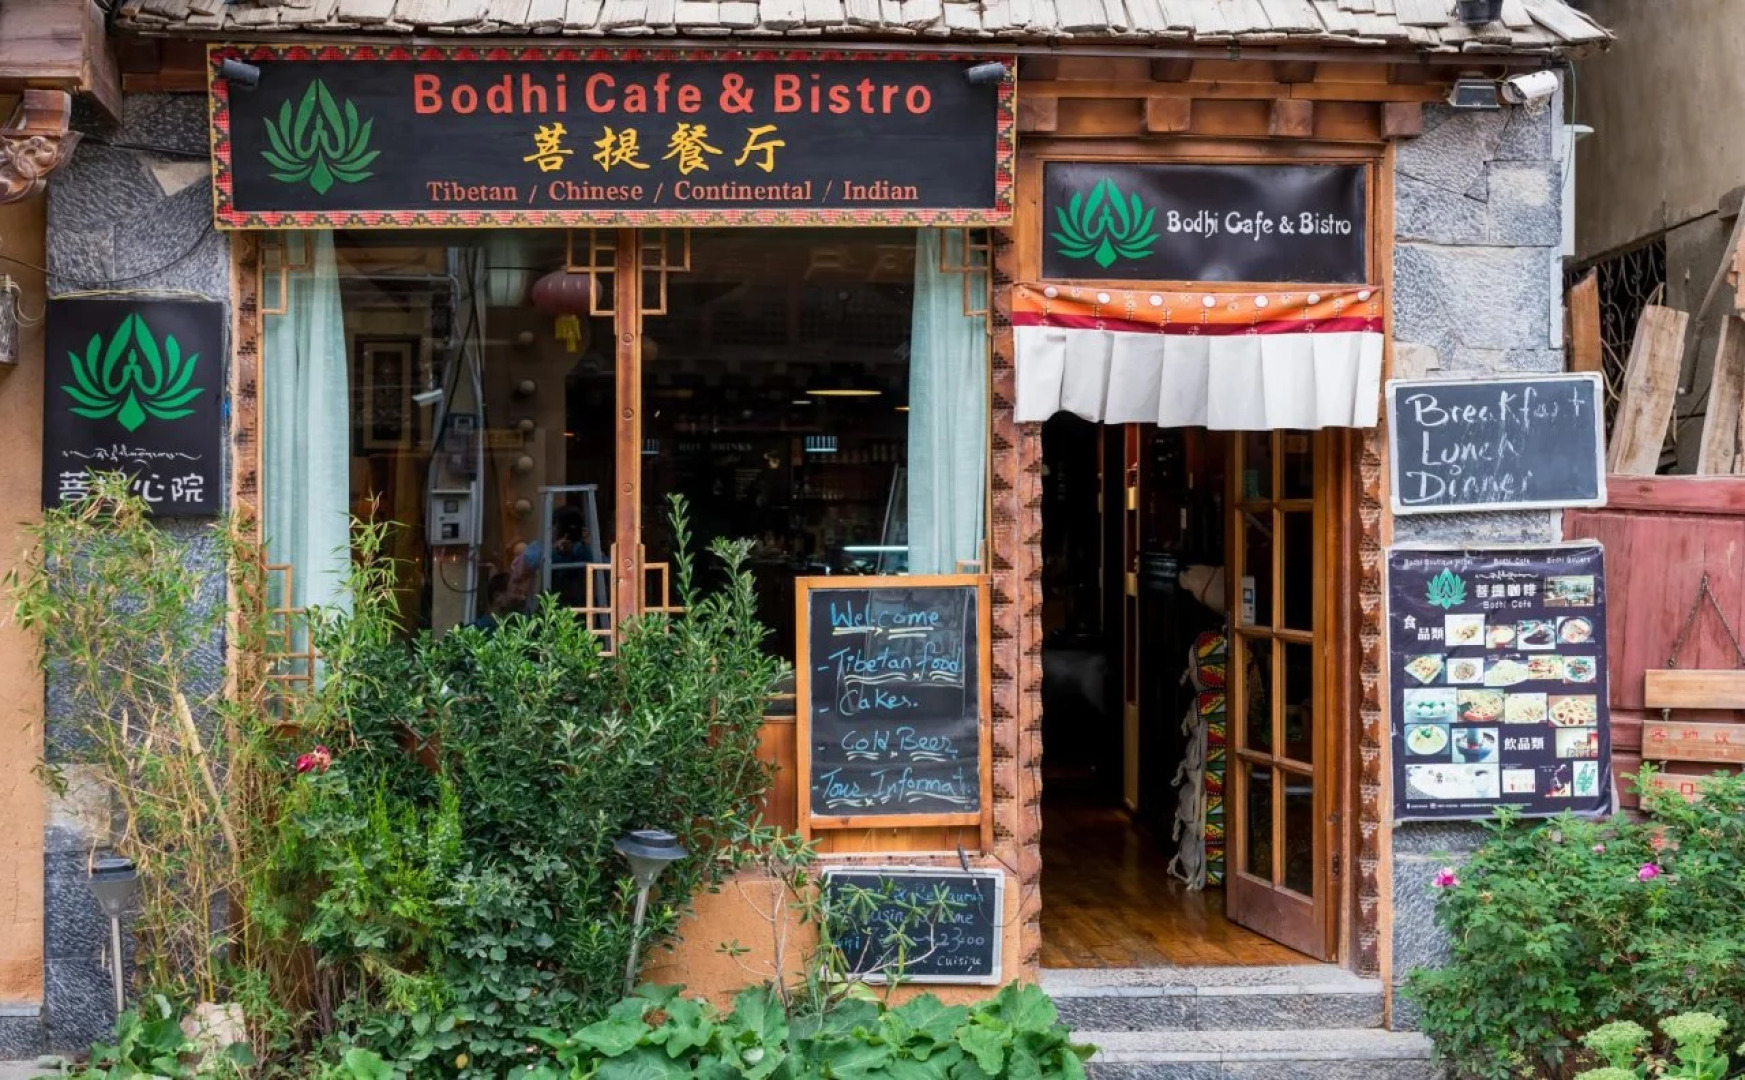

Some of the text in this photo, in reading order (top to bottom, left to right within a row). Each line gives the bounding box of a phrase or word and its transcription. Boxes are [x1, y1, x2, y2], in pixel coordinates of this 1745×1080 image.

[413, 73, 932, 114] Bodhi Cafe & Bistro
[523, 122, 786, 175] 菩提餐厅
[426, 180, 518, 202] Tibetan
[548, 180, 643, 202] Chinese
[674, 180, 812, 201] Continental
[843, 180, 919, 201] Indian
[1166, 209, 1219, 238] Bodhi
[1279, 215, 1295, 234] &
[1299, 212, 1352, 235] Bistro
[1422, 430, 1521, 466] Lunch
[59, 470, 204, 503] 菩心院
[1402, 464, 1534, 504] Dinner
[830, 600, 942, 627] Welcome
[1511, 600, 1532, 609] Cafe
[829, 641, 962, 681] Tibetan food
[841, 730, 890, 751] Cold
